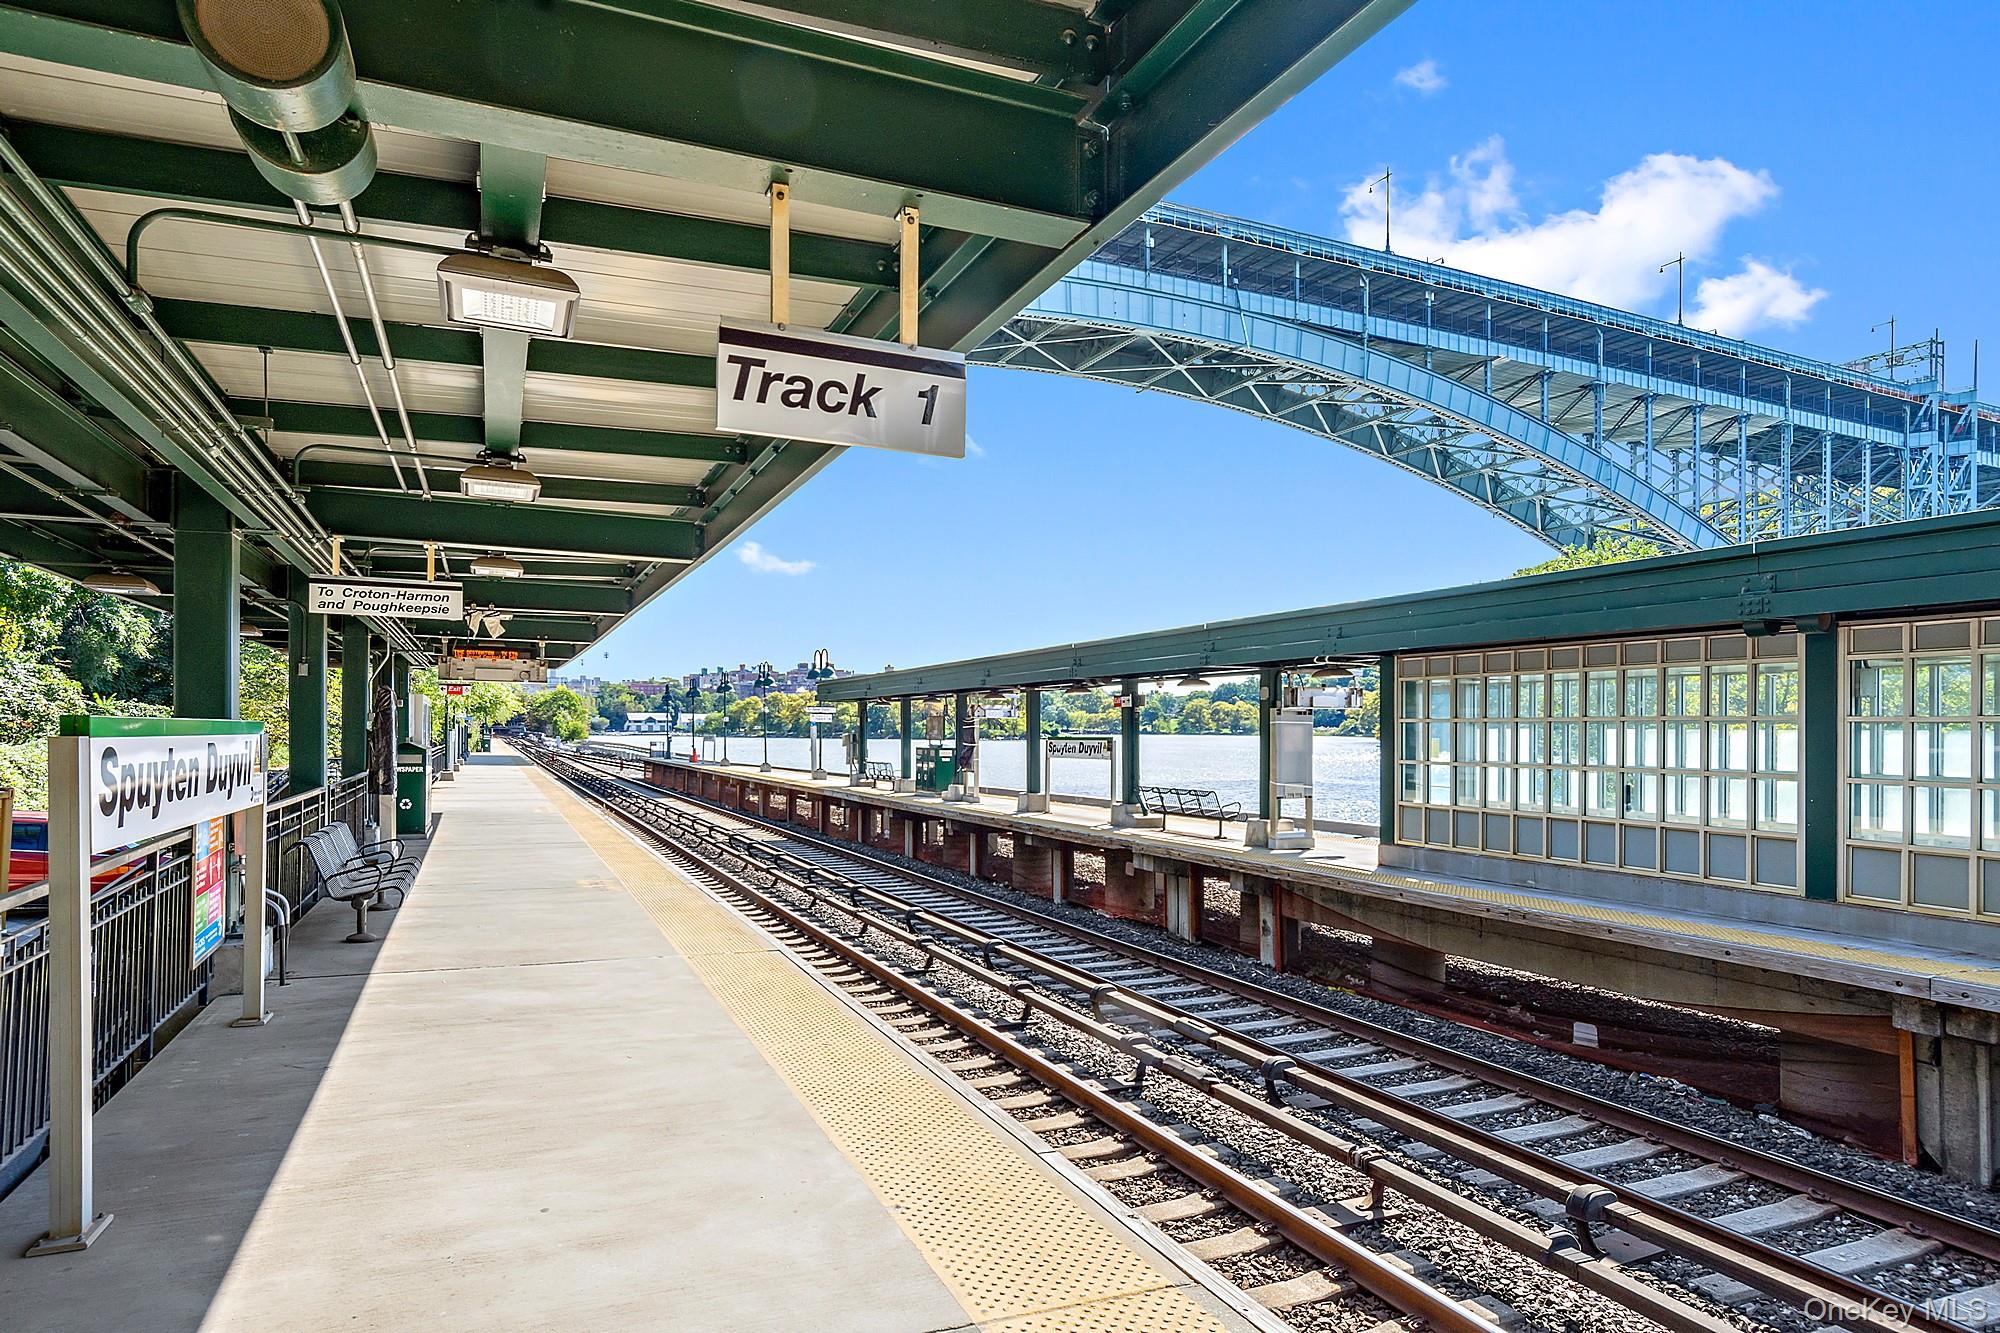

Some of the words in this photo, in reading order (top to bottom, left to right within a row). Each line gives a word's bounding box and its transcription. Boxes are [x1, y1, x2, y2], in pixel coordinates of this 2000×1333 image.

[726, 355, 883, 418] Track
[917, 384, 939, 425] 1
[318, 586, 334, 597] To
[342, 588, 450, 602] Croton-Harmon
[317, 600, 346, 610] and
[353, 600, 450, 615] Poughkeepsie
[1048, 741, 1076, 755] Spuyten
[1078, 741, 1103, 756] Duyvil
[98, 746, 199, 828] Spuyten
[205, 740, 253, 801] Duyvil
